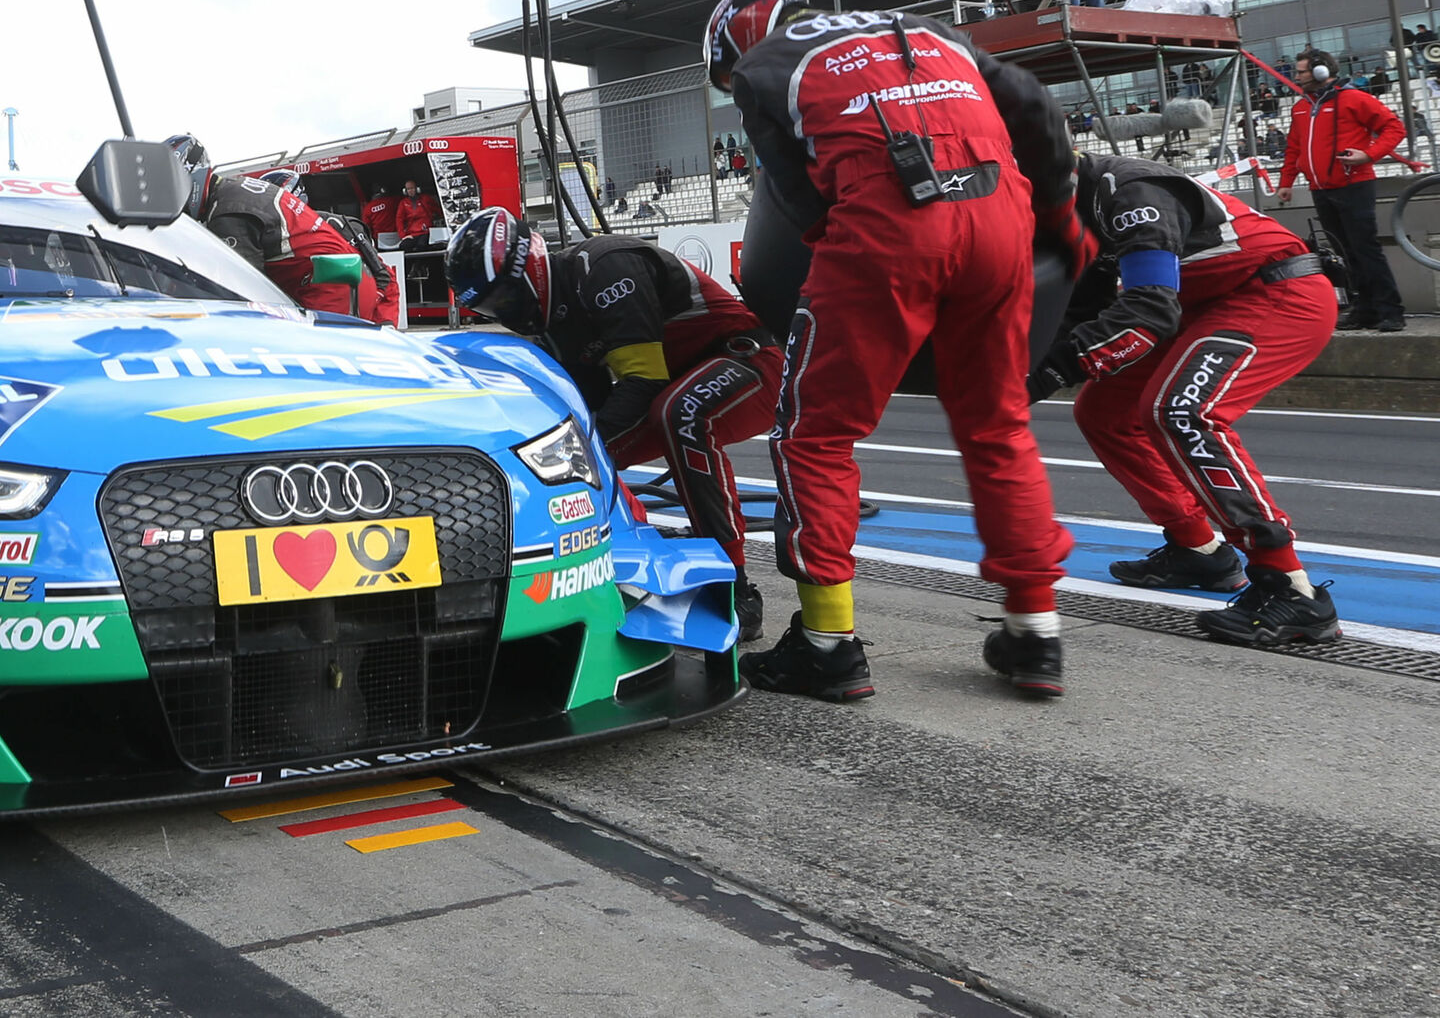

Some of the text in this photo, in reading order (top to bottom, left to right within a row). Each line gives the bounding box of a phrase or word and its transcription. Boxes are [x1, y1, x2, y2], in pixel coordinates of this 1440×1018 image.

[824, 43, 871, 70] Audi
[827, 56, 869, 77] Top
[510, 233, 541, 279] uvex
[1111, 339, 1142, 361] Sport
[677, 366, 743, 442] Audi Sport
[1168, 351, 1224, 460] Audi Sport
[561, 493, 595, 520] Castrol
[189, 528, 205, 542] 5
[559, 524, 599, 557] EDGE
[280, 742, 492, 779] Audi Sport
